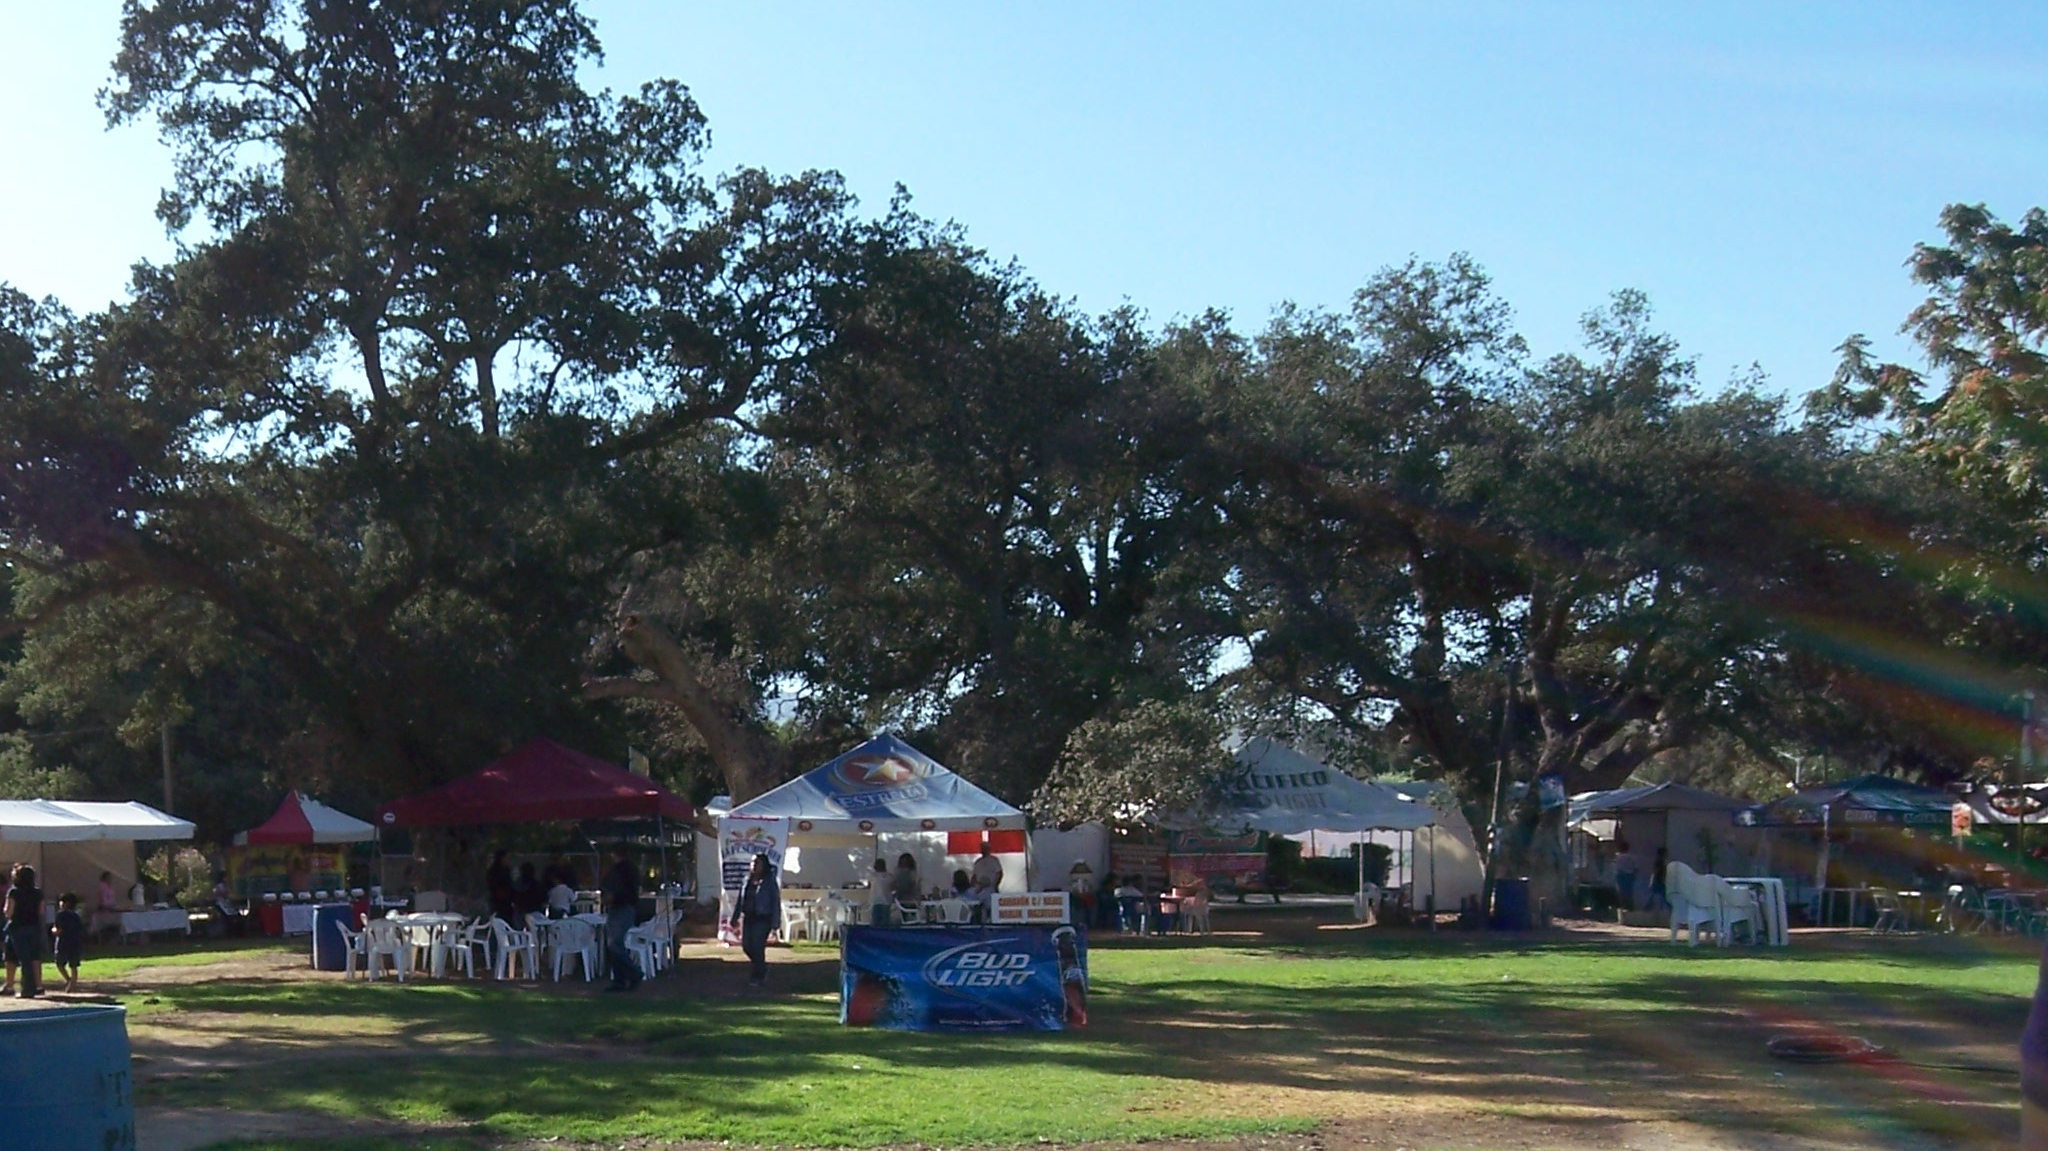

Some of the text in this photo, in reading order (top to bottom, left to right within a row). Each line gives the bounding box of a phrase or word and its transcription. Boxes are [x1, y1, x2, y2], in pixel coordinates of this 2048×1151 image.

[839, 785, 921, 808] ESTRELLA
[955, 952, 1031, 969] BUD
[936, 970, 1036, 987] LIGHT
